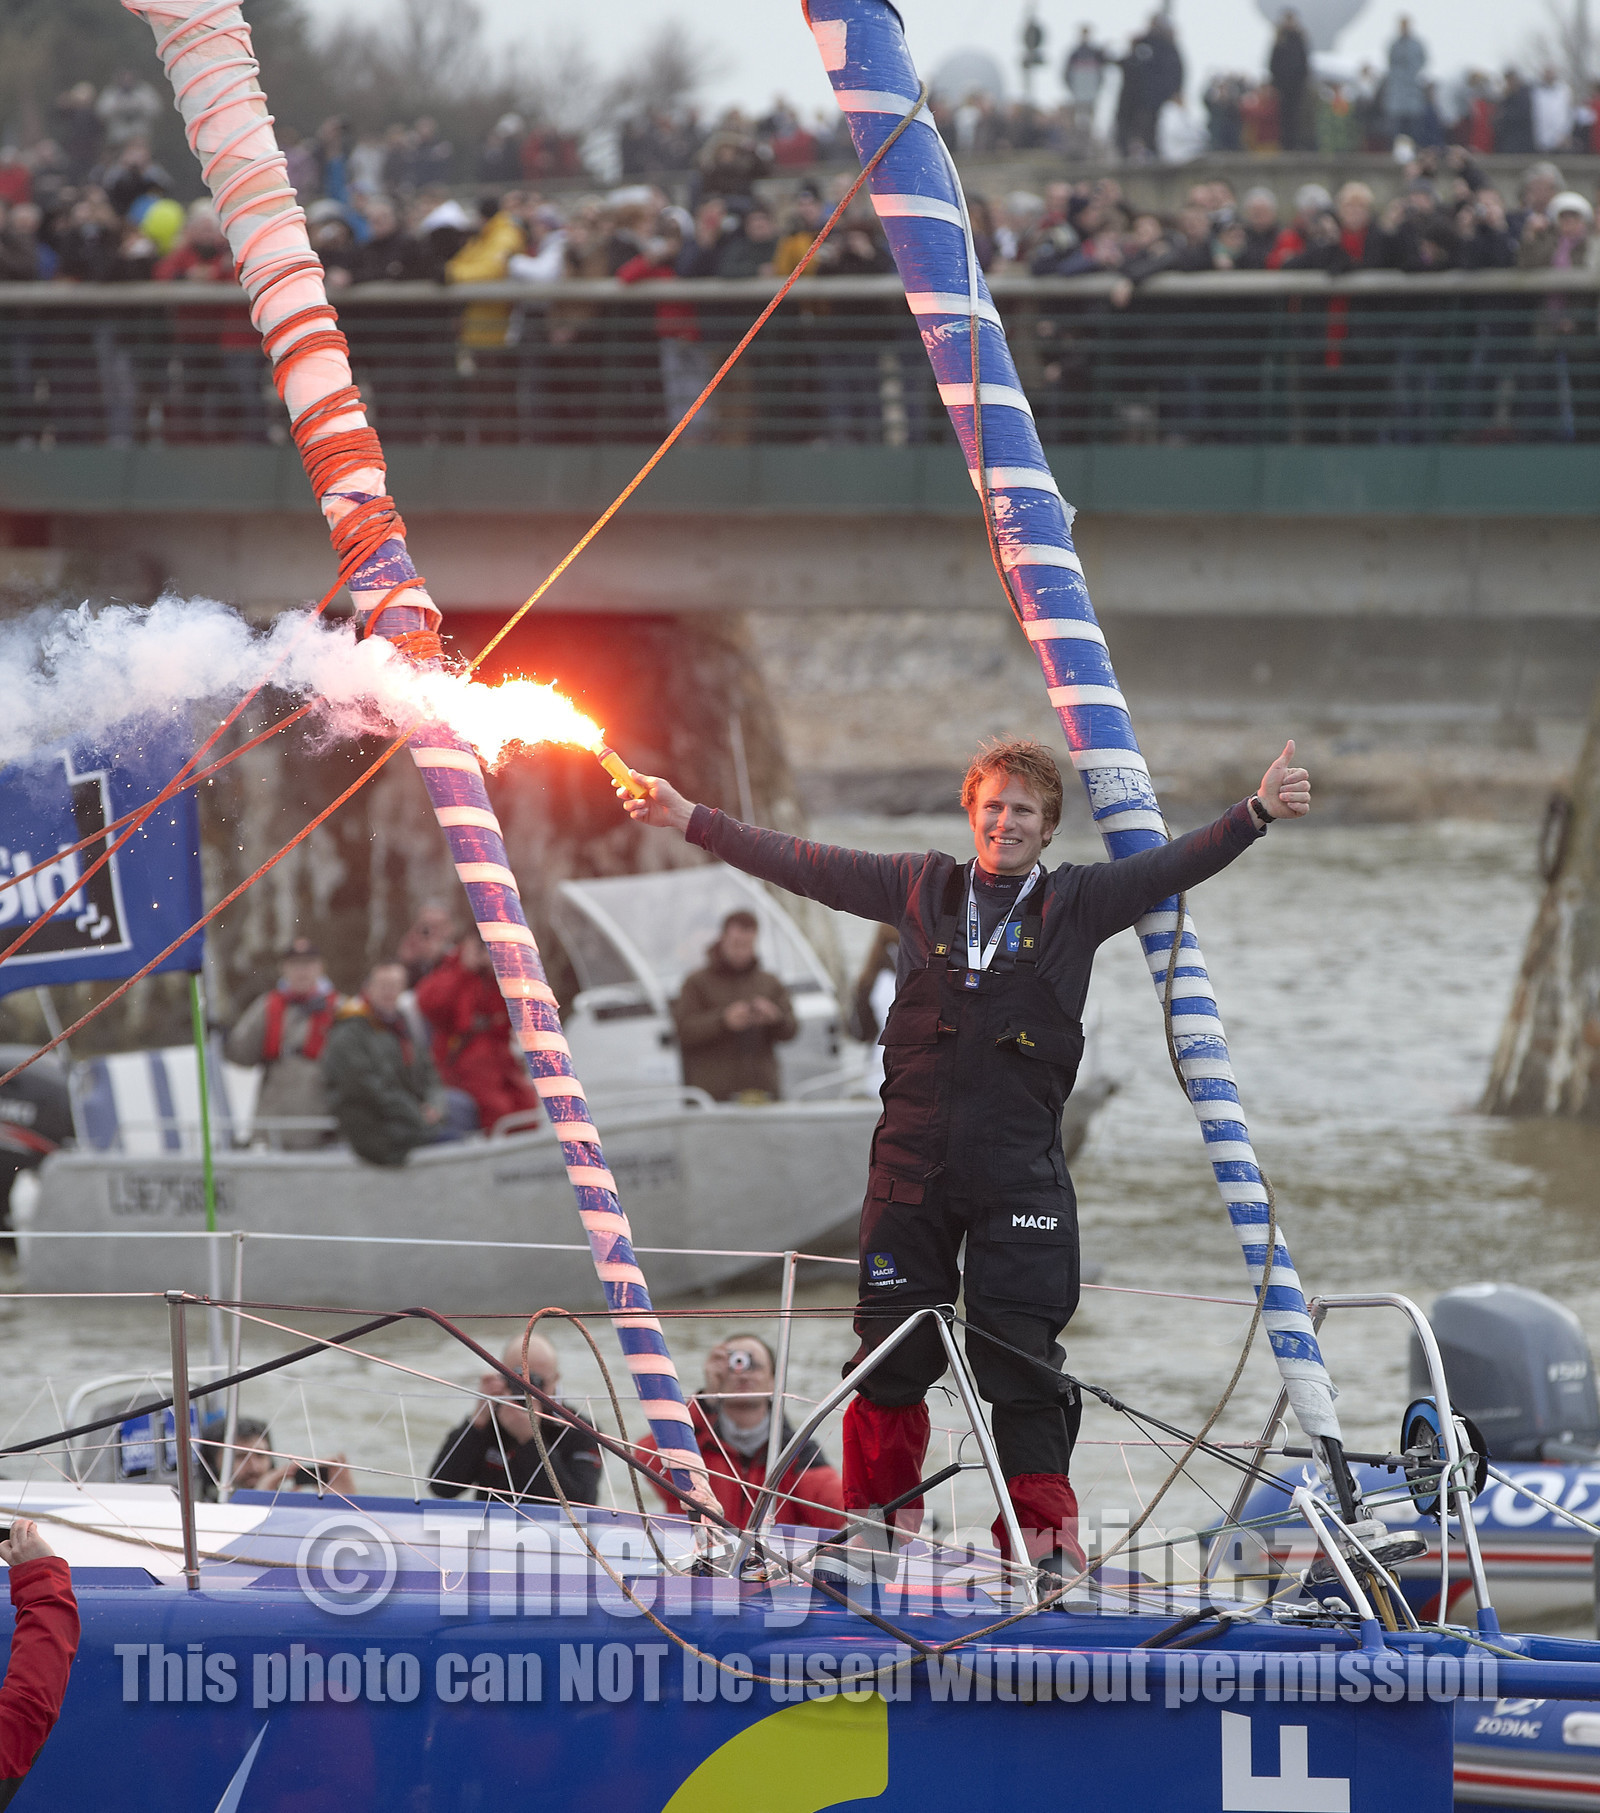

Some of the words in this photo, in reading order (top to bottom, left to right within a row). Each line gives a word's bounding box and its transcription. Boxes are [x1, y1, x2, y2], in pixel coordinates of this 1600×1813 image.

[1012, 1213, 1058, 1231] MACIF
[872, 1268, 895, 1276] MACIF
[1474, 1715, 1543, 1739] ZODIAC
